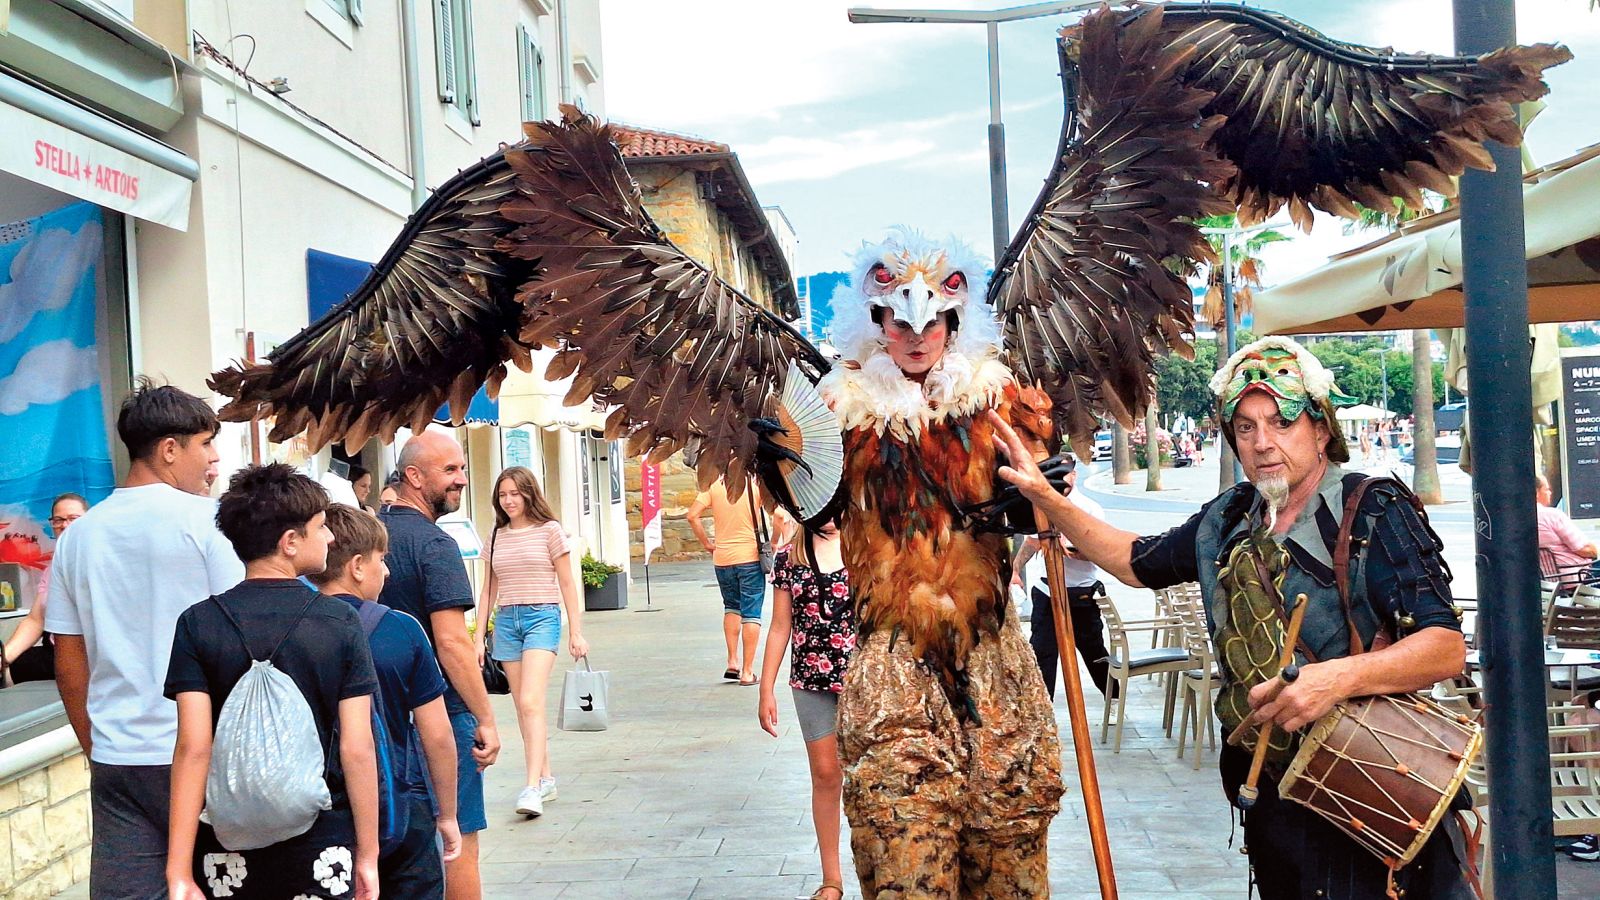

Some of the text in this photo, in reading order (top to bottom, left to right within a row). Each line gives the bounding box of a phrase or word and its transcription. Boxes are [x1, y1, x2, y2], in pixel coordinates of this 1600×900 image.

[34, 139, 139, 200] STELLA ARTOIS
[648, 465, 656, 507] AKTIV
